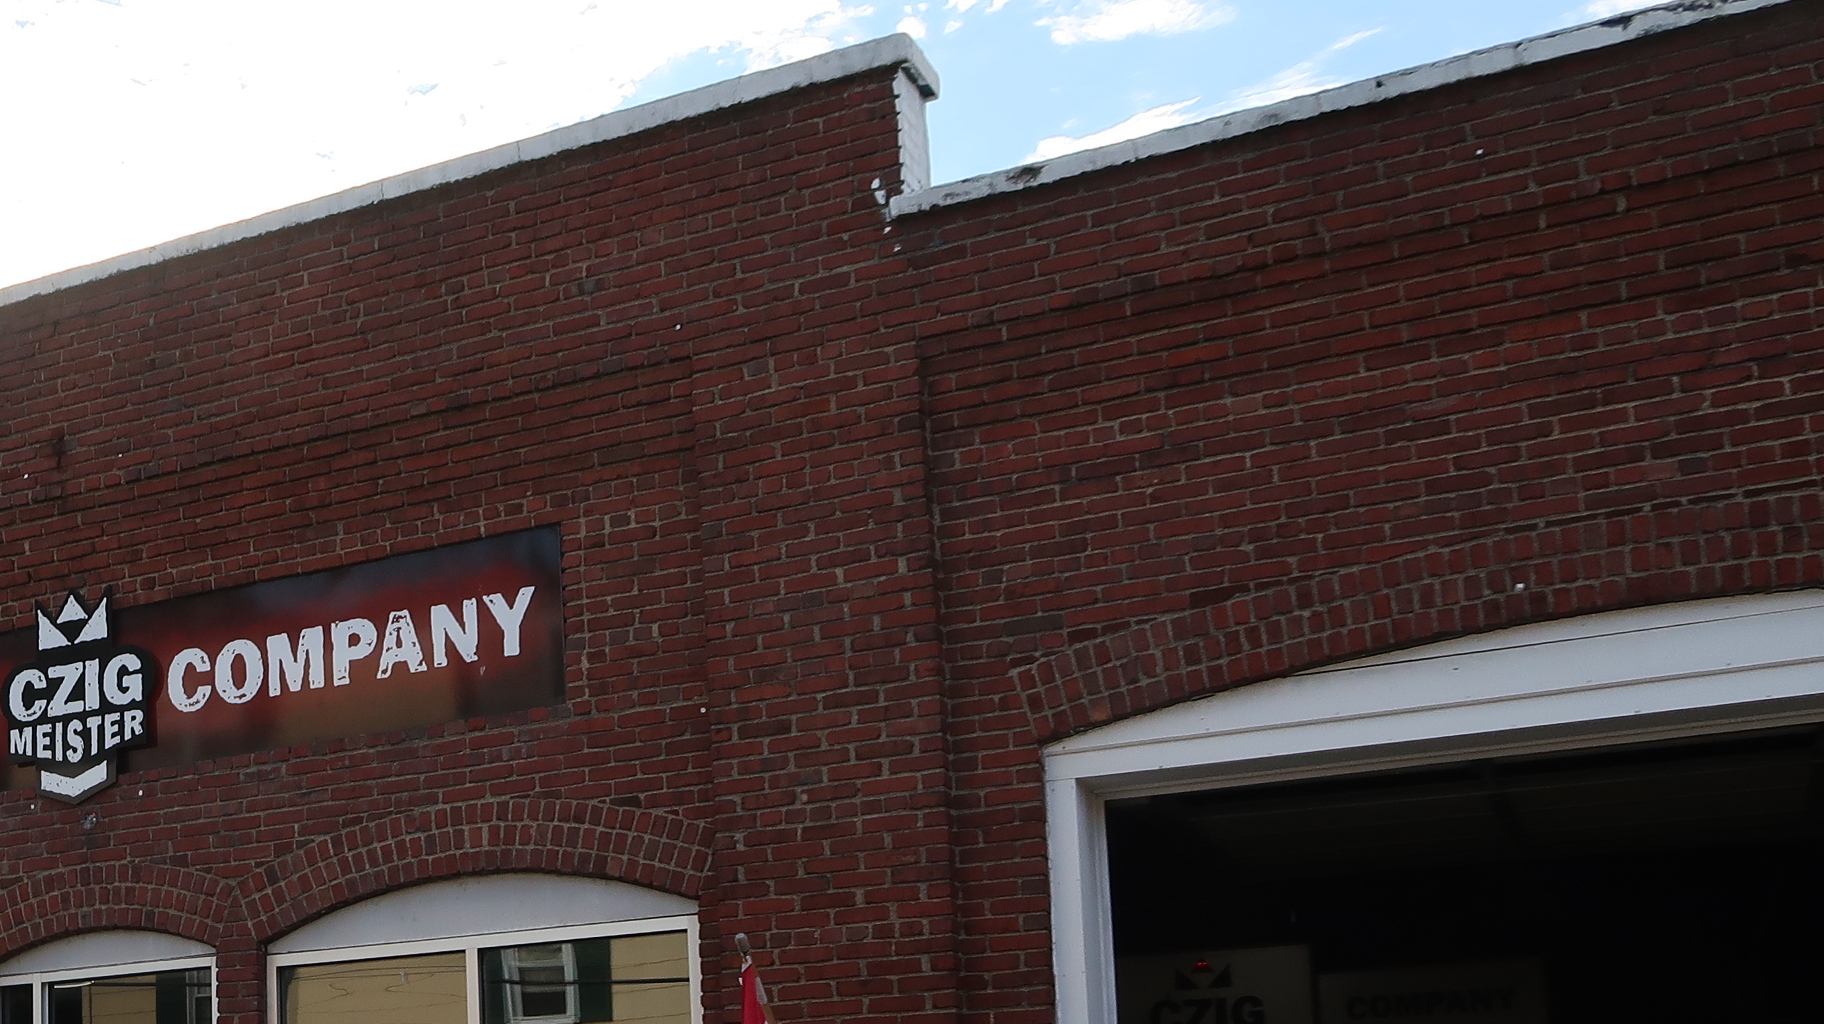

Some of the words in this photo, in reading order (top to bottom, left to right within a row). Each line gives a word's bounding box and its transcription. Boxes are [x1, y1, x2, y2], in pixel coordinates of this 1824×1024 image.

[167, 586, 536, 712] COMPANY
[9, 653, 143, 722] CZIG
[10, 709, 144, 763] MEISTER
[1347, 986, 1518, 1019] COMPANY
